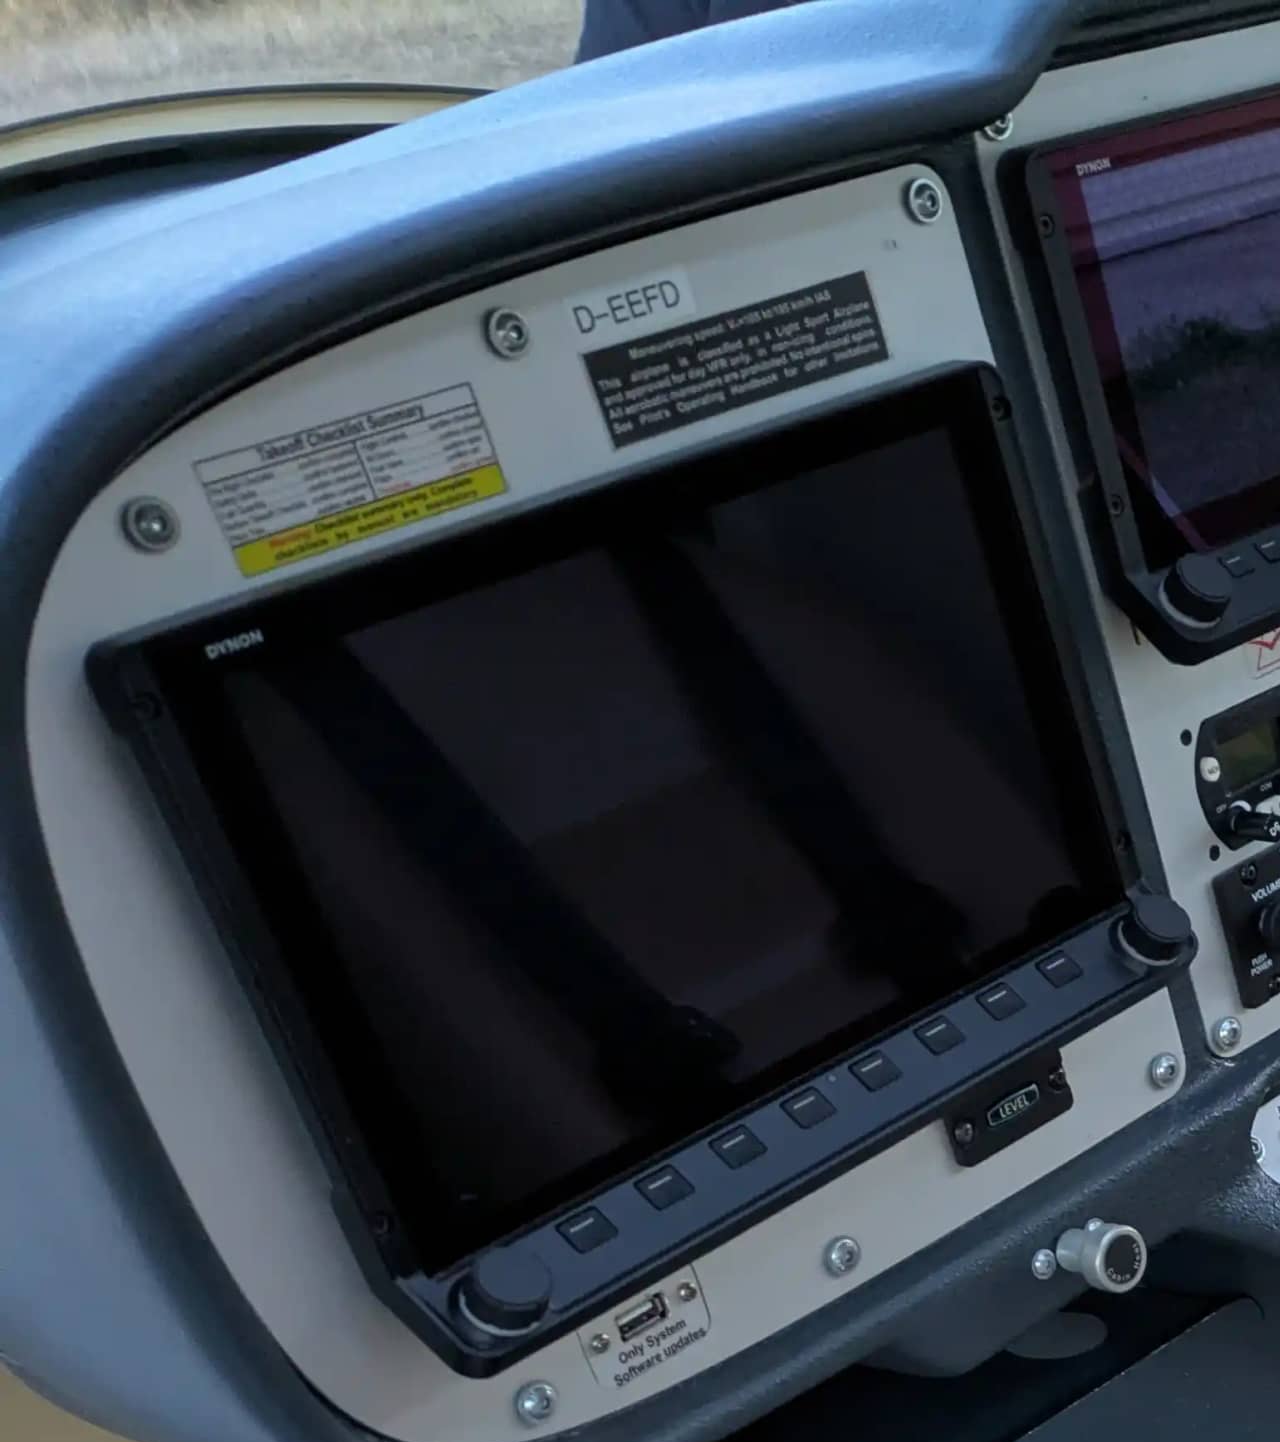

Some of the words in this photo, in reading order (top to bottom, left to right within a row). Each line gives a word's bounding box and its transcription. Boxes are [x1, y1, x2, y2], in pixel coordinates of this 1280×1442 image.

[1075, 157, 1111, 176] DYNON
[572, 279, 681, 334] D-EEFD
[598, 375, 621, 392] This
[305, 417, 365, 448] Checklist
[365, 399, 425, 433] Summary
[204, 628, 264, 660] DYNON
[1250, 959, 1273, 976] POWER
[1251, 952, 1268, 967] PUSH
[999, 1094, 1029, 1119] LEVEL
[618, 1343, 645, 1364] Only
[646, 1320, 687, 1348] System
[613, 1352, 663, 1387] Software
[663, 1327, 707, 1358] updates
